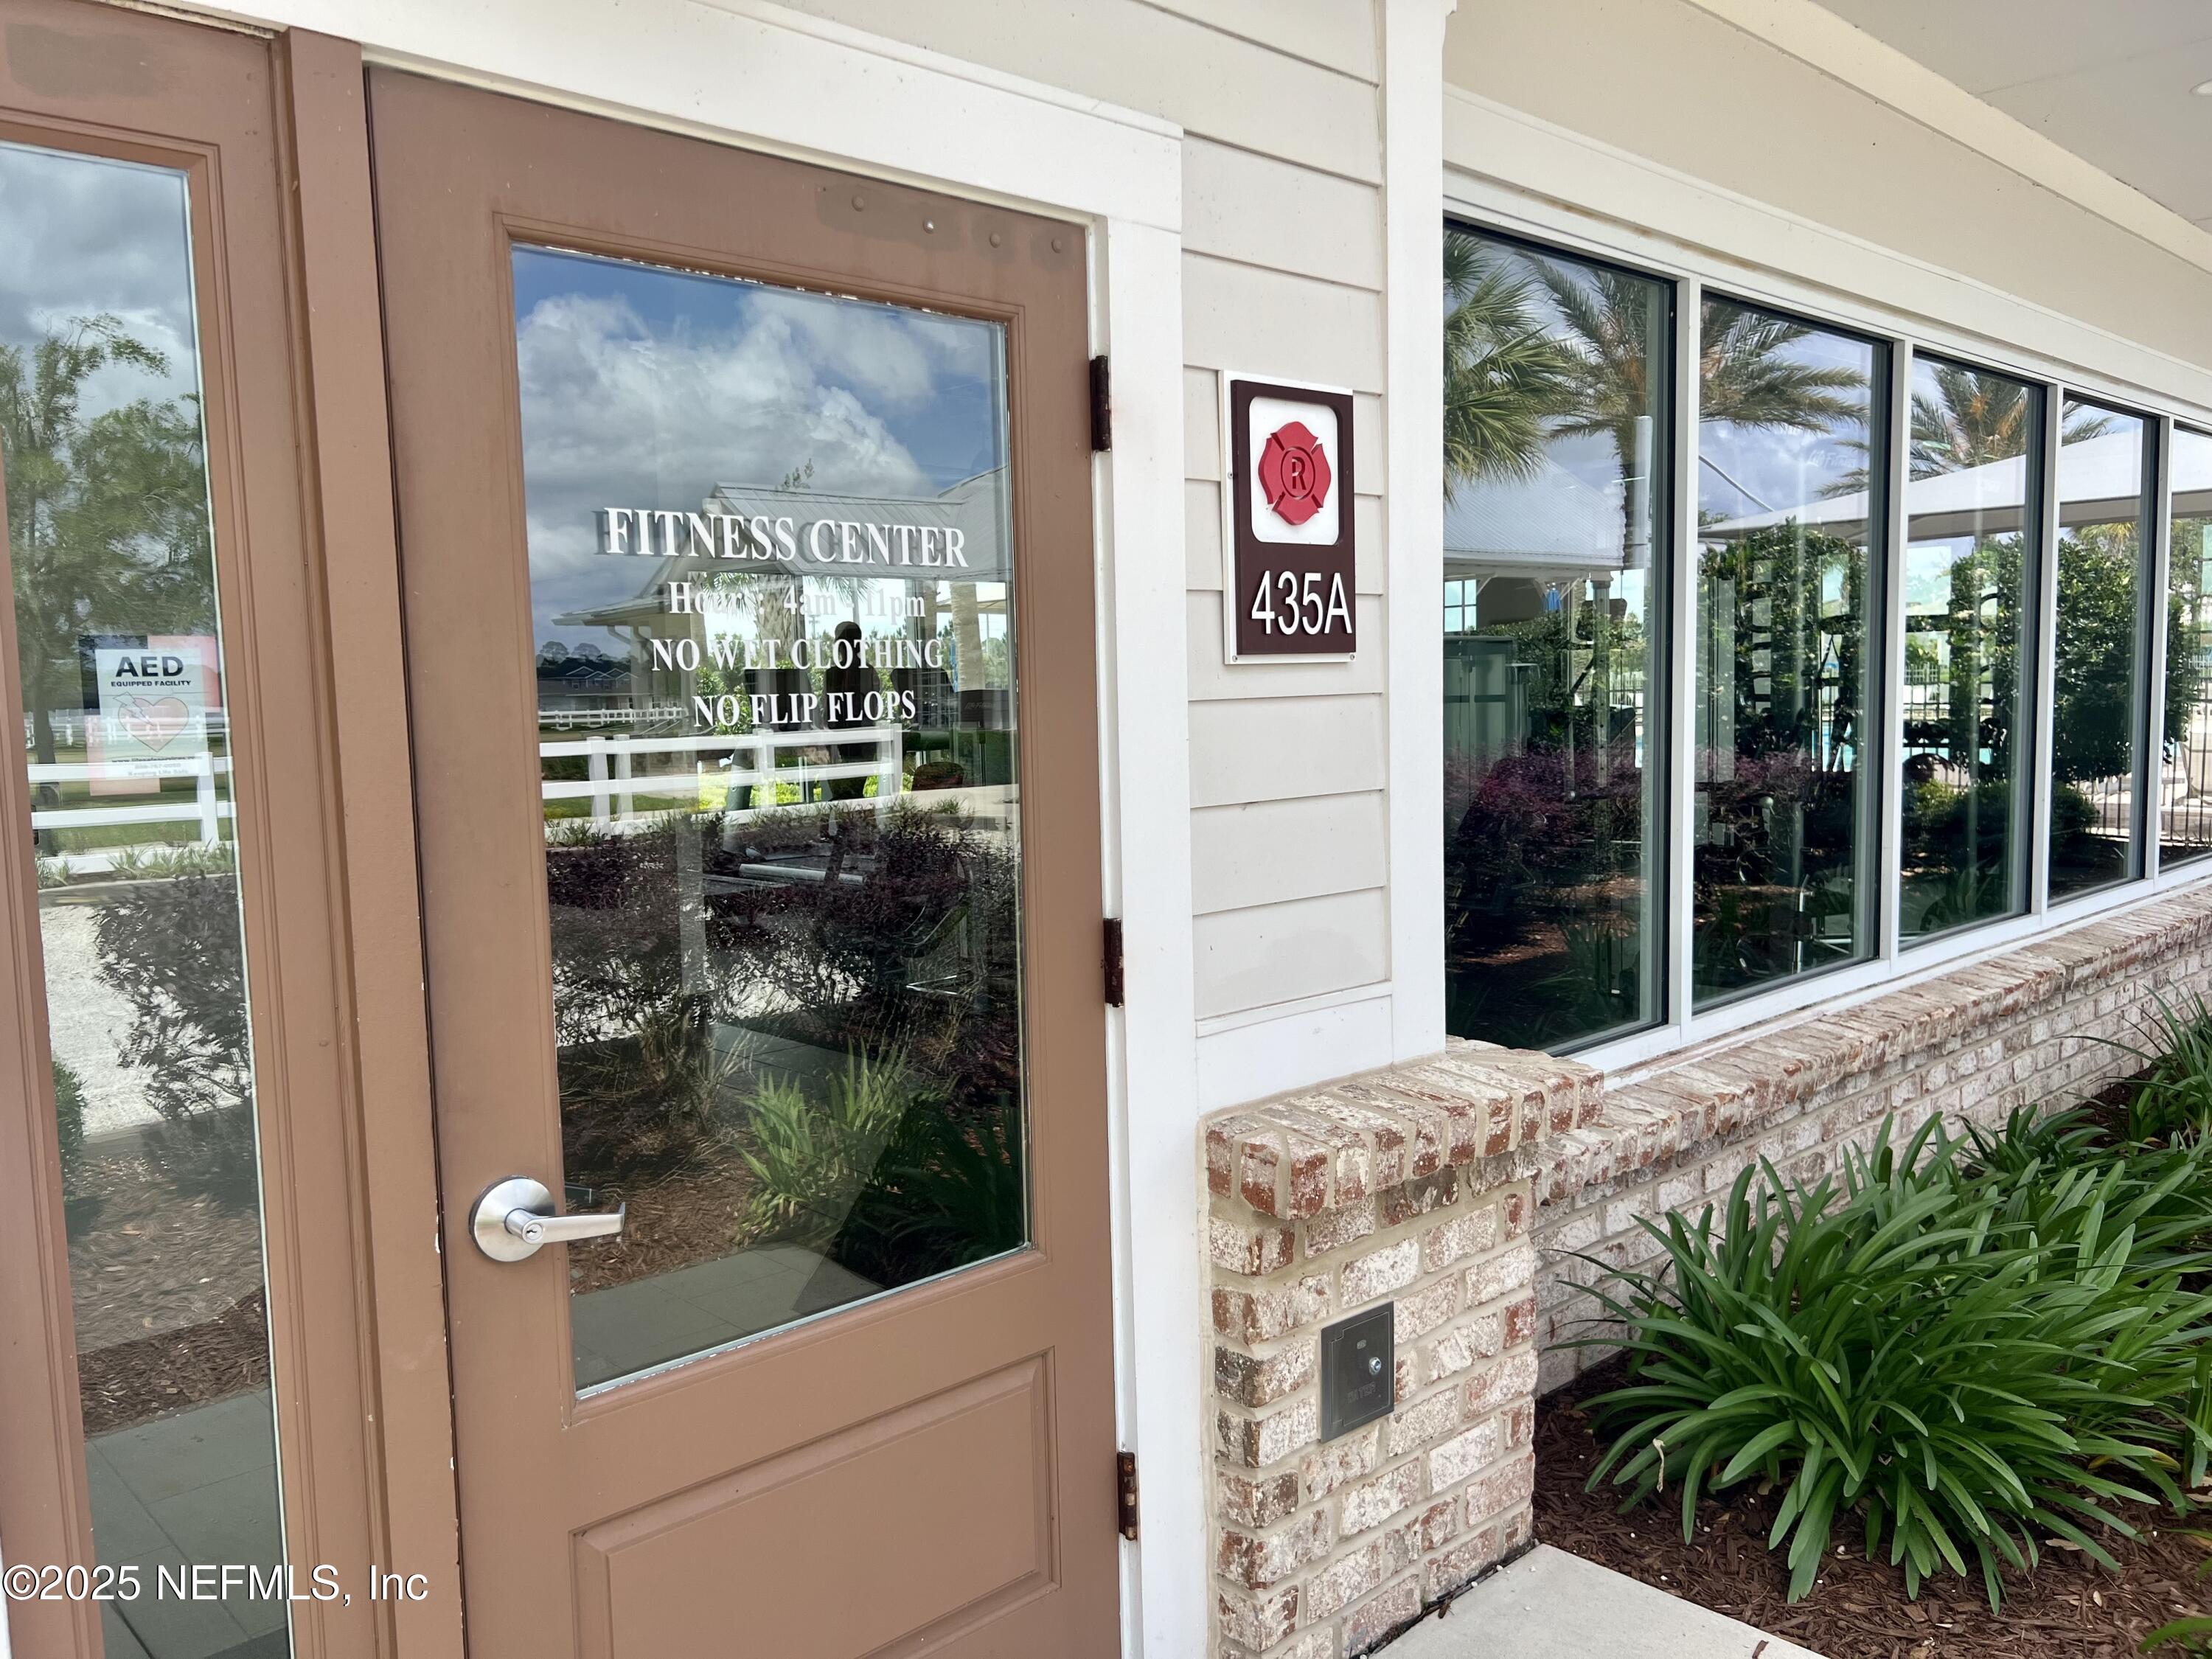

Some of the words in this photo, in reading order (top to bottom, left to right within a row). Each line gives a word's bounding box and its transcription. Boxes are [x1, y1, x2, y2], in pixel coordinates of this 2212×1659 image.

[1291, 456, 1306, 490] R
[604, 507, 796, 560] FITNESS
[810, 519, 969, 568] CENTER
[784, 585, 838, 616] 4am
[866, 588, 926, 626] 11pm
[1251, 570, 1352, 635] 435A
[116, 656, 184, 677] AED
[650, 639, 700, 671] NO
[710, 639, 781, 670] WET
[791, 639, 943, 670] CLOTHING
[692, 694, 740, 727] NO
[749, 693, 818, 725] FLIP
[827, 690, 916, 723] FLOPS
